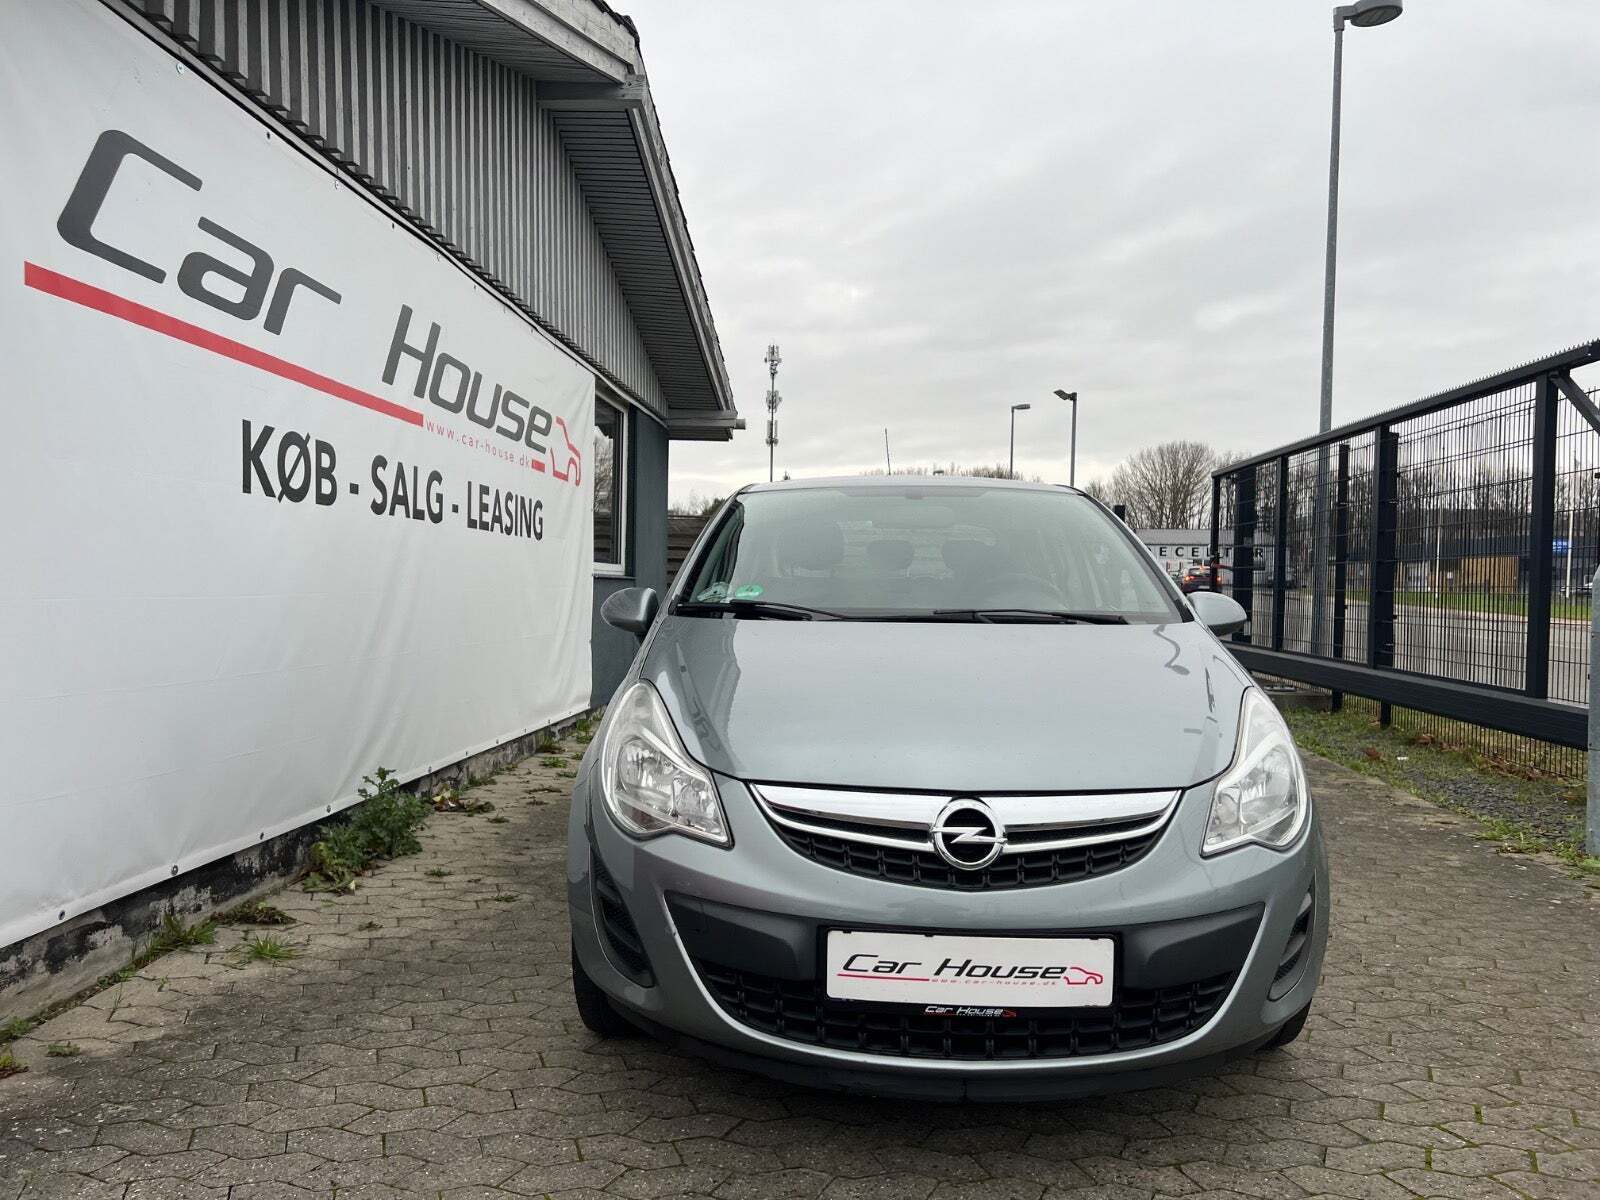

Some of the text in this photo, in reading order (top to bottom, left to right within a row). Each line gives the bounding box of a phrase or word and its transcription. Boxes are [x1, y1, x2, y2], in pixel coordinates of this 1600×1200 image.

[57, 130, 552, 454] Car House
[425, 419, 531, 469] www.car-house.dk
[243, 419, 337, 506] KØB
[371, 455, 443, 524] SALG
[467, 481, 543, 541] LEASING
[842, 953, 1068, 979] Car House
[925, 1005, 953, 1013] Car
[956, 1006, 1004, 1015] House
